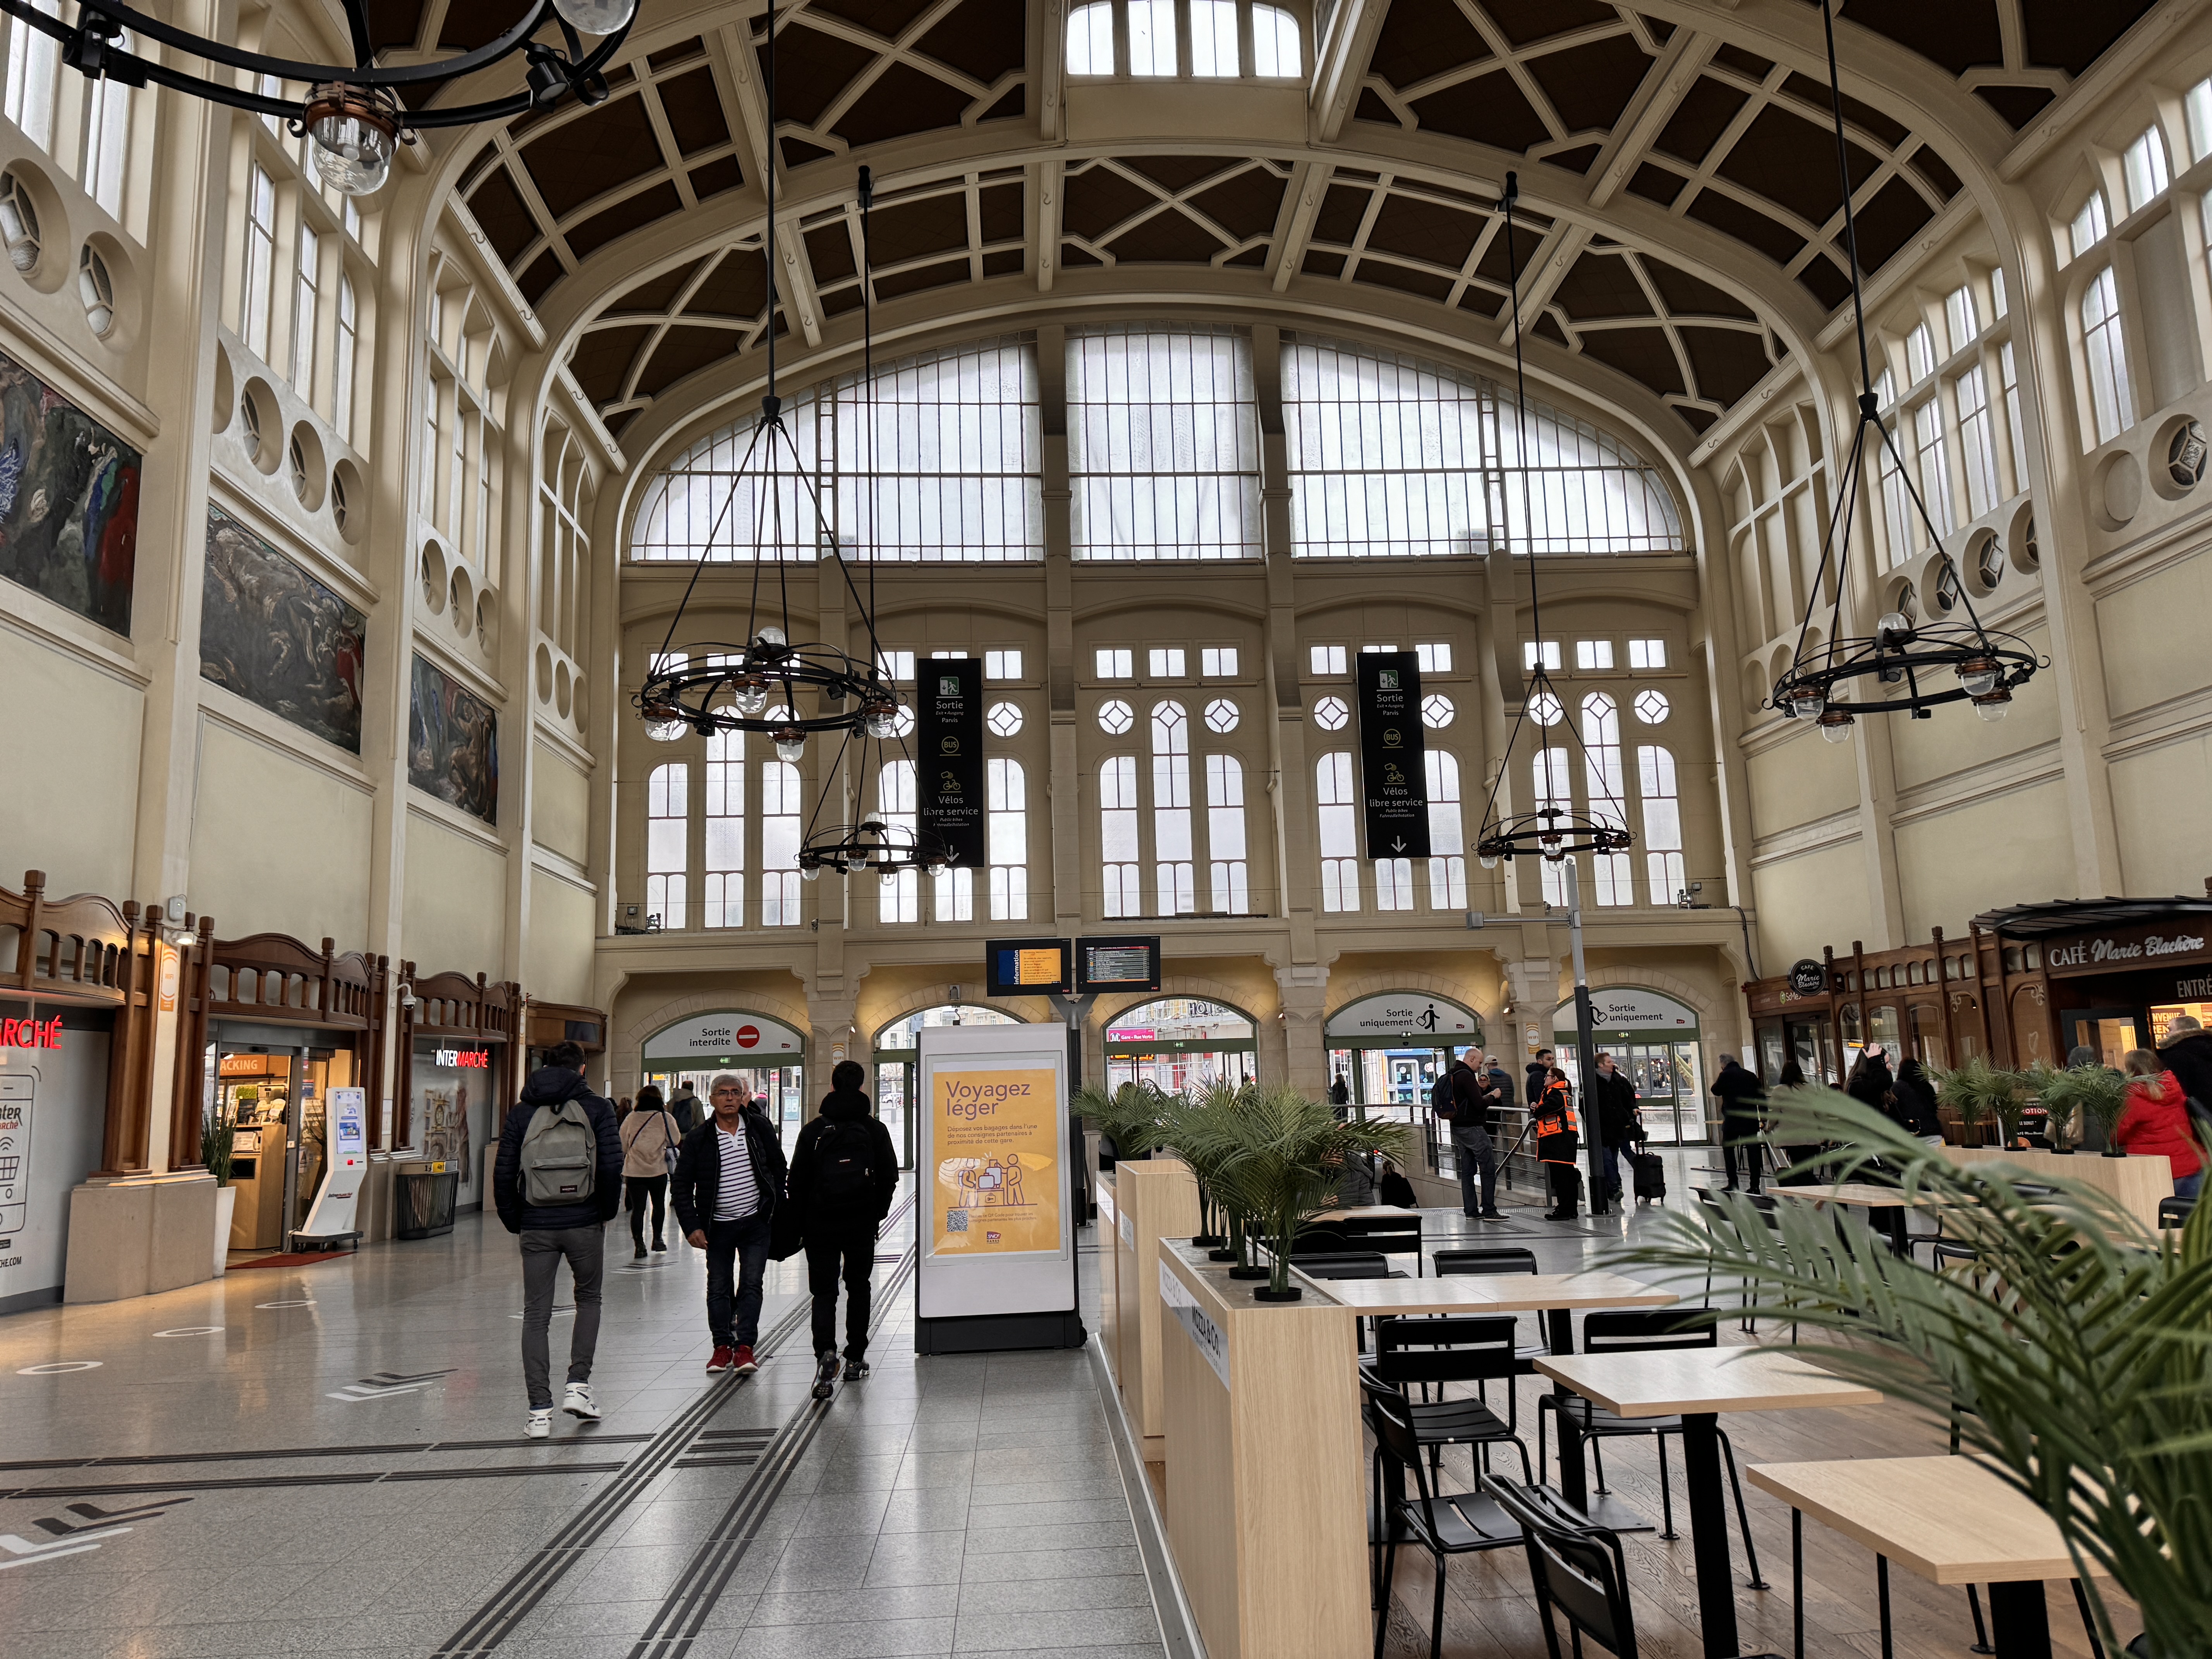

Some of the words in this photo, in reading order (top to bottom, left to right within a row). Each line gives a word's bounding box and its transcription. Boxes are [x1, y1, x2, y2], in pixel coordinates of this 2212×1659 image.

[1377, 694, 1403, 702] Sortie
[1383, 787, 1408, 795] Vélos
[1392, 798, 1423, 806] service
[924, 807, 944, 816] libre
[947, 807, 978, 815] service
[2050, 940, 2088, 967] CAFÉ
[2091, 938, 2143, 962] Marie
[2144, 934, 2205, 957] Blachère
[1796, 974, 1820, 982] Marie
[1610, 1013, 1663, 1022] uniquement
[1360, 1019, 1413, 1028] uniquement
[0, 1015, 62, 1049] RCHÉ
[702, 1028, 730, 1036] Sortie
[690, 1038, 730, 1046] interdite
[436, 1049, 488, 1068] INTERMARCHÉ
[946, 1081, 1030, 1102] Voyagez
[947, 1098, 998, 1120] léger
